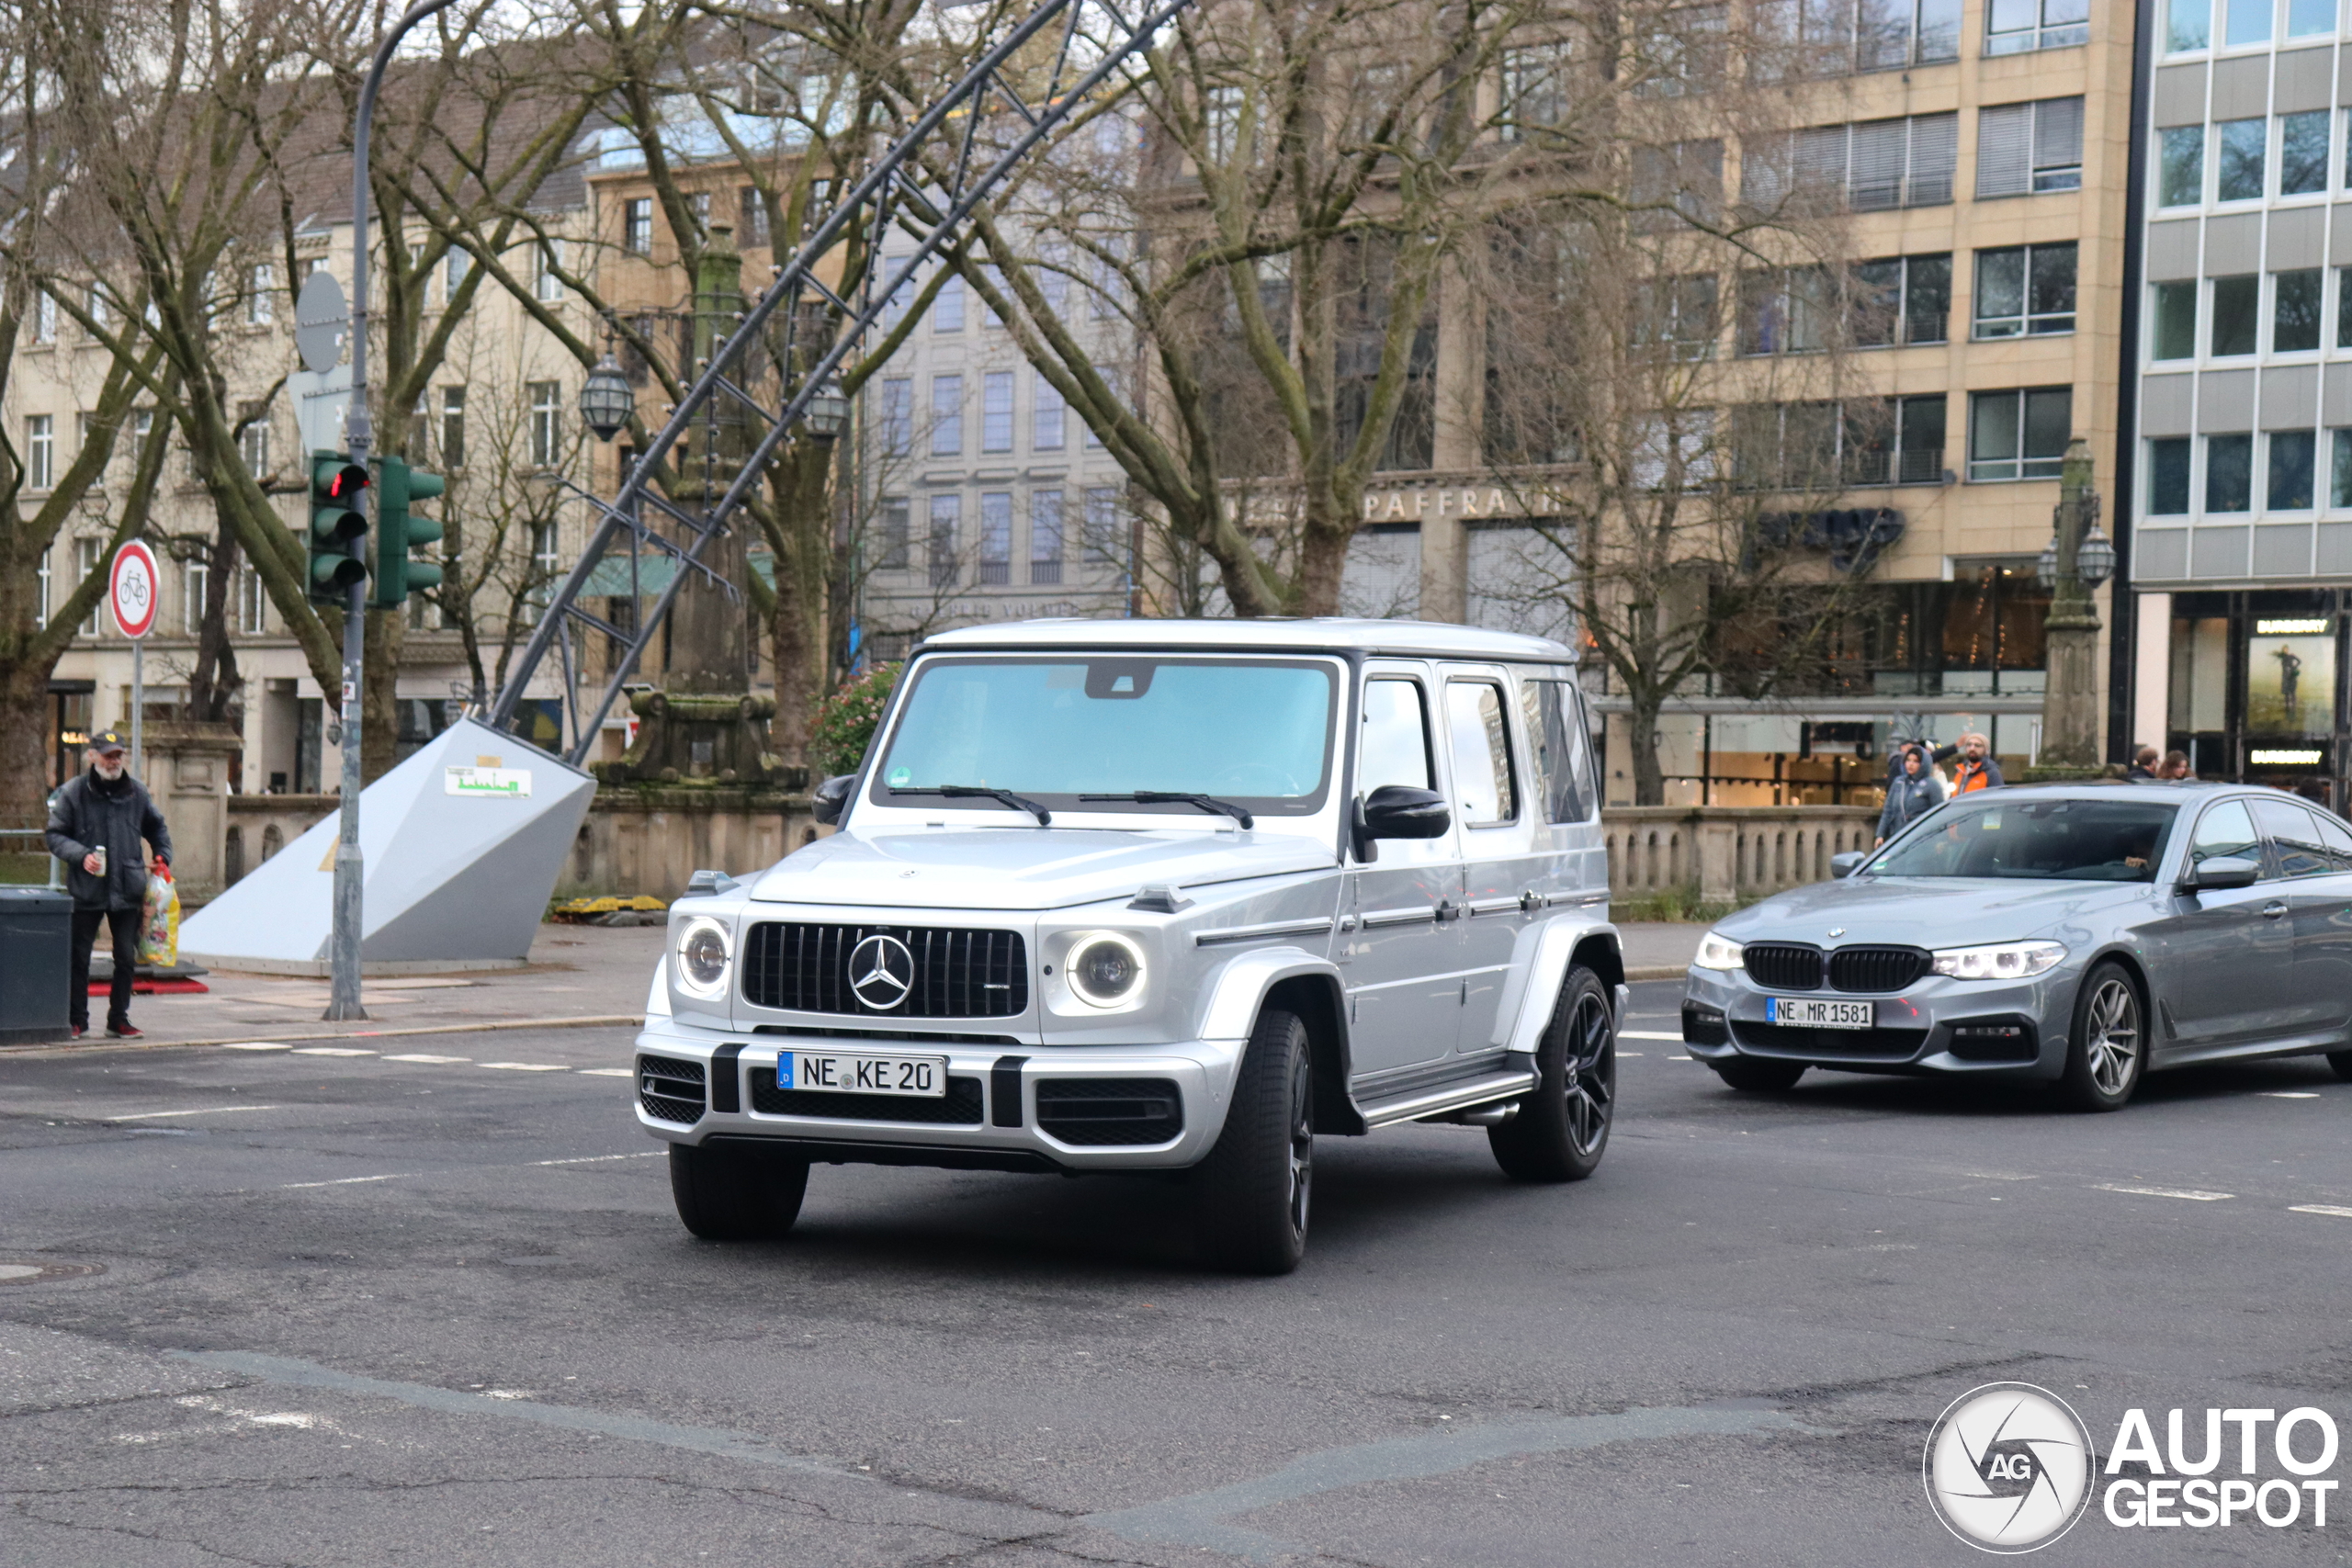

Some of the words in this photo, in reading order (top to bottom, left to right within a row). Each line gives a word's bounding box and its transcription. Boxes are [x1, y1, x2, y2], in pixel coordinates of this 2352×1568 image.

[1363, 486, 1562, 519] PAFFRATH
[2256, 619, 2328, 633] BURBERRY
[2251, 750, 2323, 764] BURBERRY
[1777, 1001, 1795, 1020] NE
[1807, 1002, 1826, 1021] MR
[1830, 1004, 1870, 1024] 1581
[783, 1073, 789, 1082] D
[804, 1057, 838, 1086] NE
[857, 1060, 891, 1089] KE
[899, 1062, 932, 1090] 20
